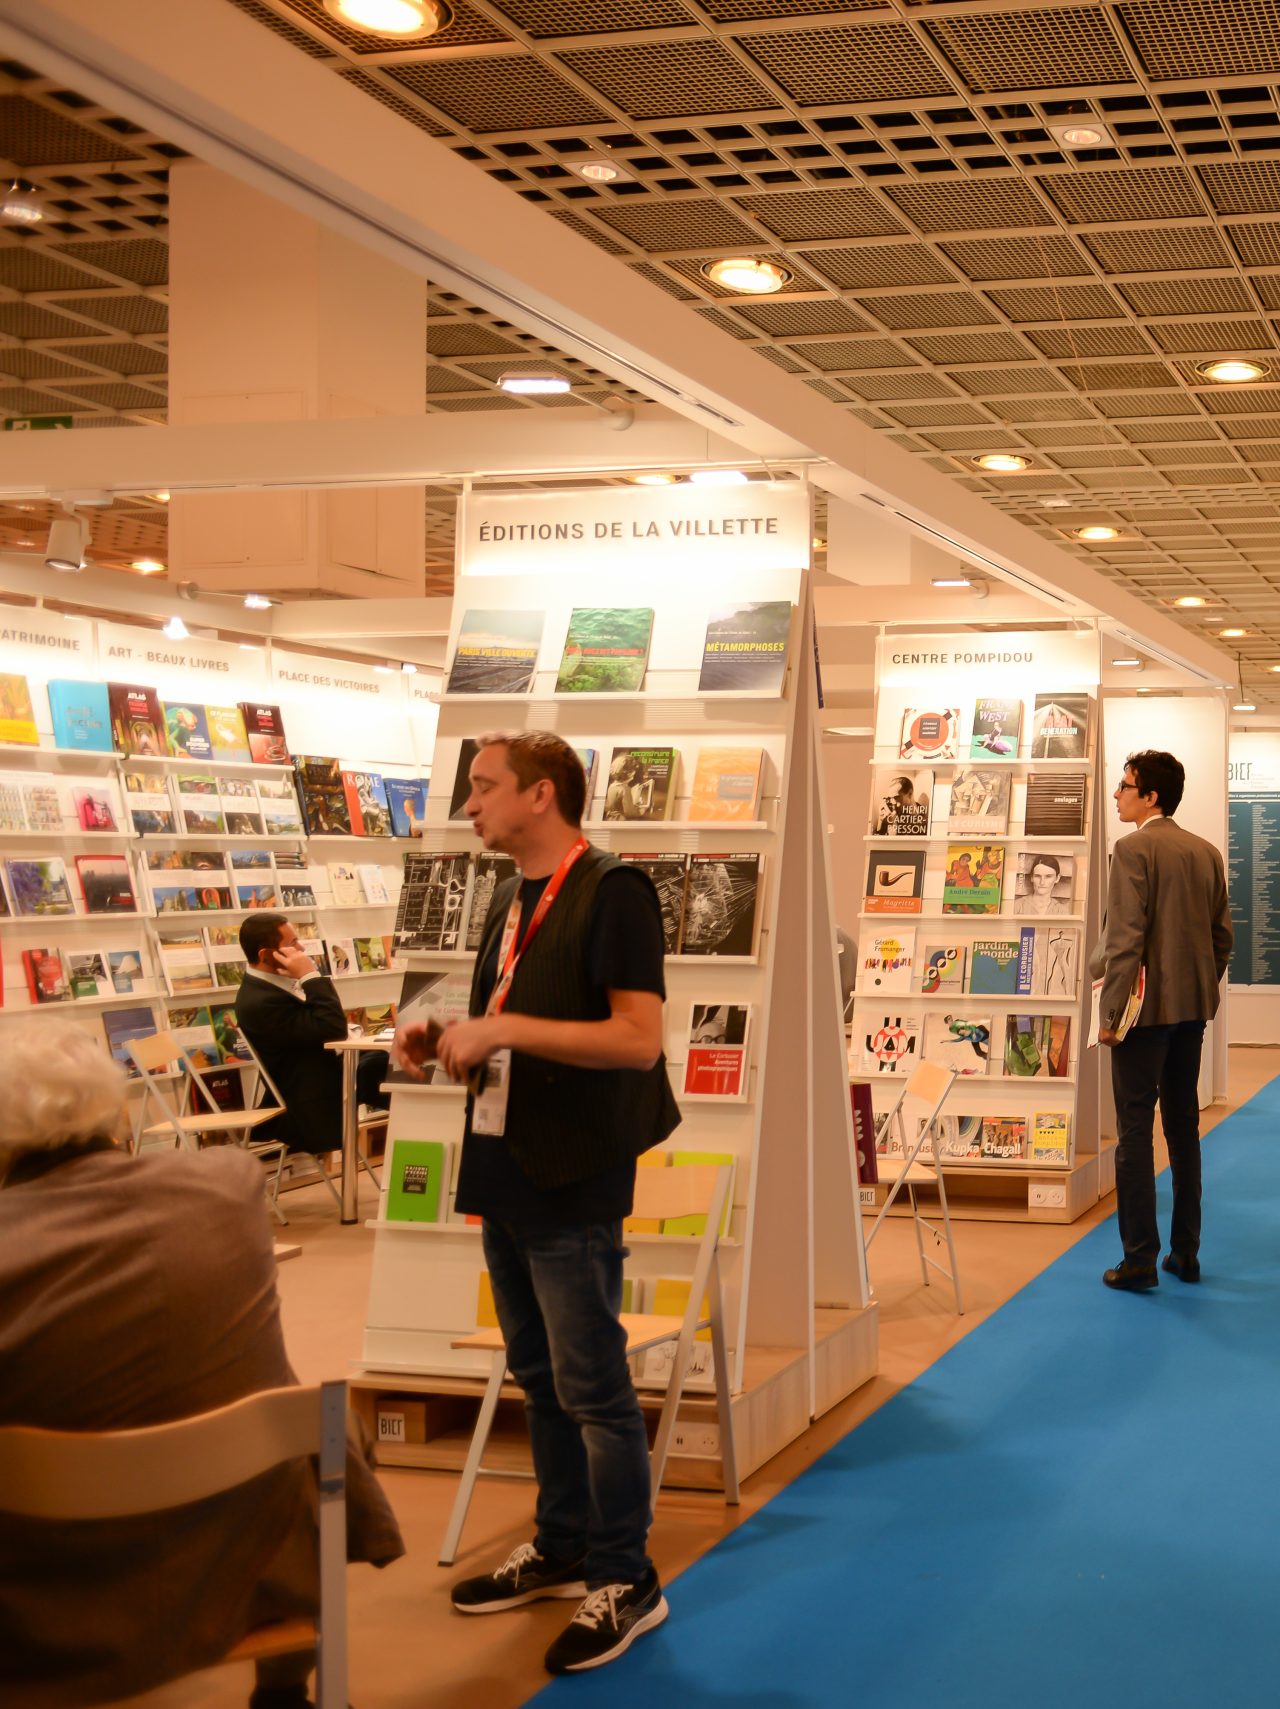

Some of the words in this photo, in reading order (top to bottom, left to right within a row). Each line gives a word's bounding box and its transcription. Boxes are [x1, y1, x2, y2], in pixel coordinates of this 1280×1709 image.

[479, 521, 585, 543] ÉDITIONS
[594, 520, 622, 539] DE
[632, 519, 660, 538] LA
[669, 517, 779, 538] VILLETTE
[0, 629, 80, 651] ATRIMOINE
[706, 641, 785, 652] MÉTAMORPHOSES
[108, 646, 133, 658] ART
[147, 651, 187, 667] BEAUX
[190, 658, 231, 673] LIVRES
[892, 654, 949, 665] CENTRE
[953, 652, 1034, 664] POMPIDOU
[278, 669, 310, 684] PLACE
[313, 675, 331, 687] DES
[334, 678, 380, 694] VICTOIRES
[979, 711, 1010, 723] WEST
[346, 774, 381, 789] ROME
[902, 805, 928, 815] HENRI
[886, 814, 927, 824] CARTIER-
[884, 899, 915, 907] Magritte
[974, 942, 1008, 952] jardin
[980, 948, 1019, 959] monde
[1021, 936, 1029, 974] CORBUSIER
[1021, 975, 1027, 984] LE
[945, 1141, 980, 1157] Kupka
[984, 1142, 1021, 1158] Chagall
